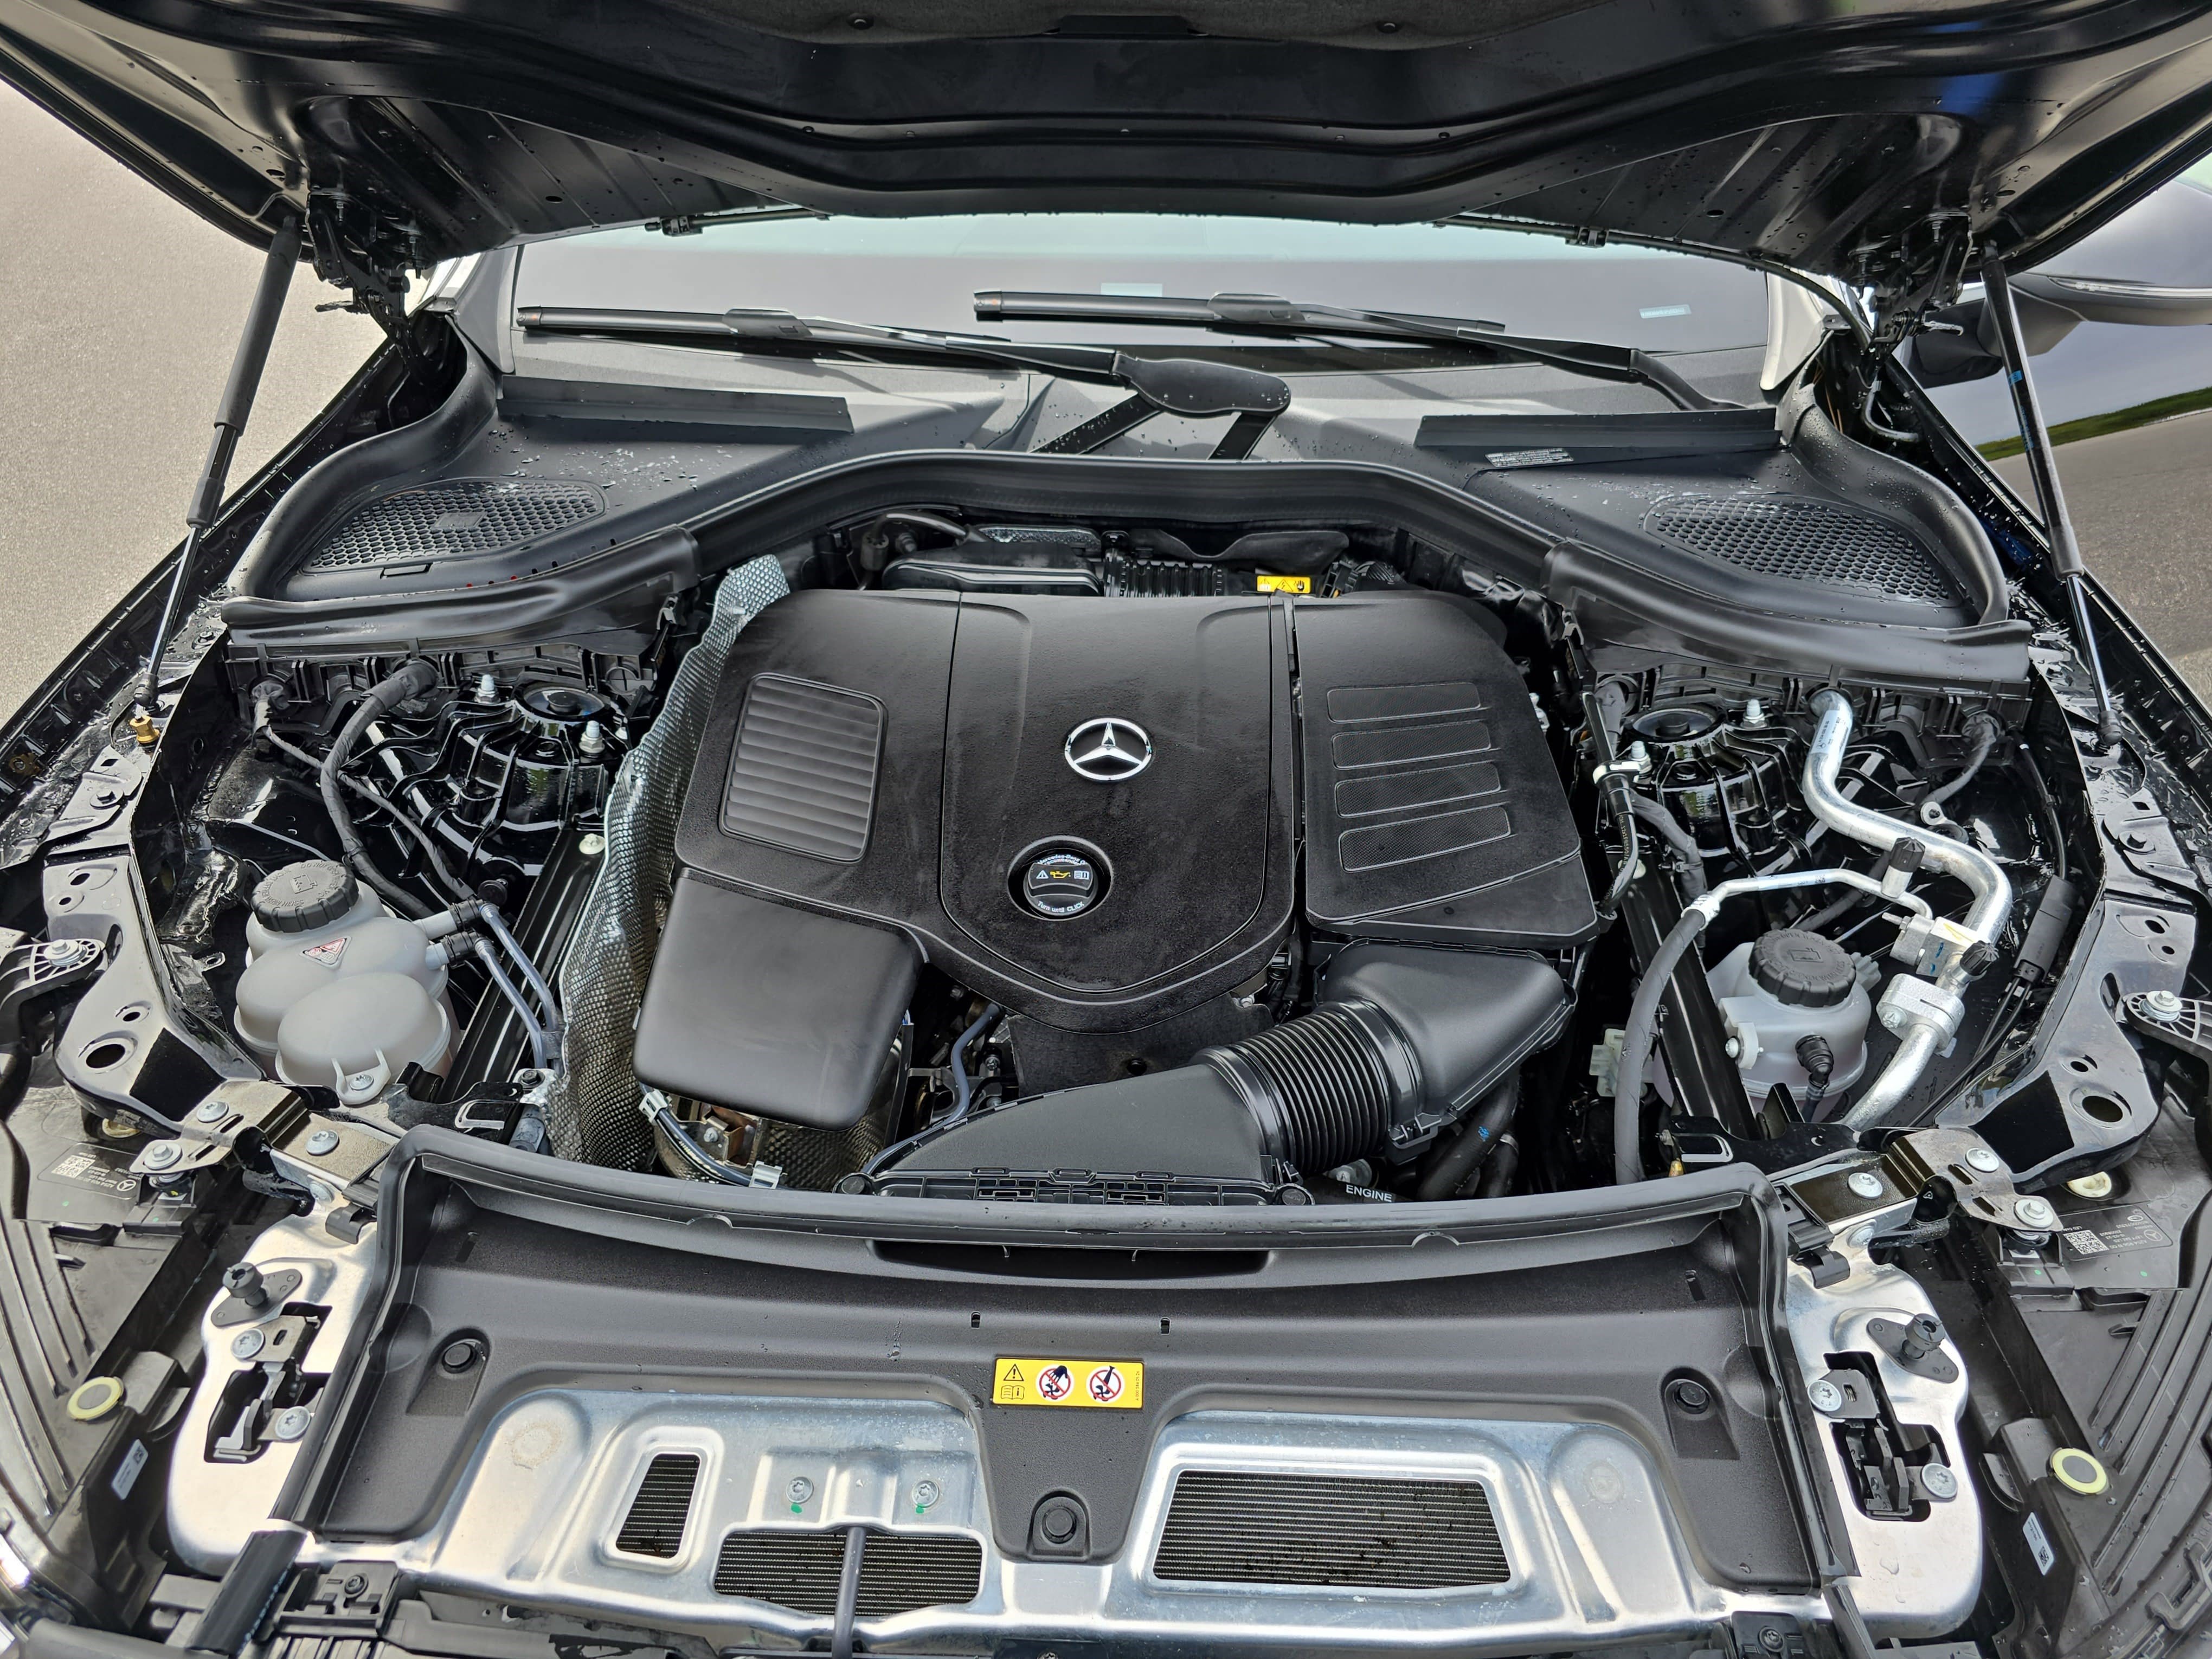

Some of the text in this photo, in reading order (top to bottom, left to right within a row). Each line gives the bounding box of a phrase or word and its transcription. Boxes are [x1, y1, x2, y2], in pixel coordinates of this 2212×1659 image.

[1038, 901, 1050, 911] Turn
[1066, 901, 1085, 911] CLICK
[1346, 1184, 1392, 1203] ENGINE
